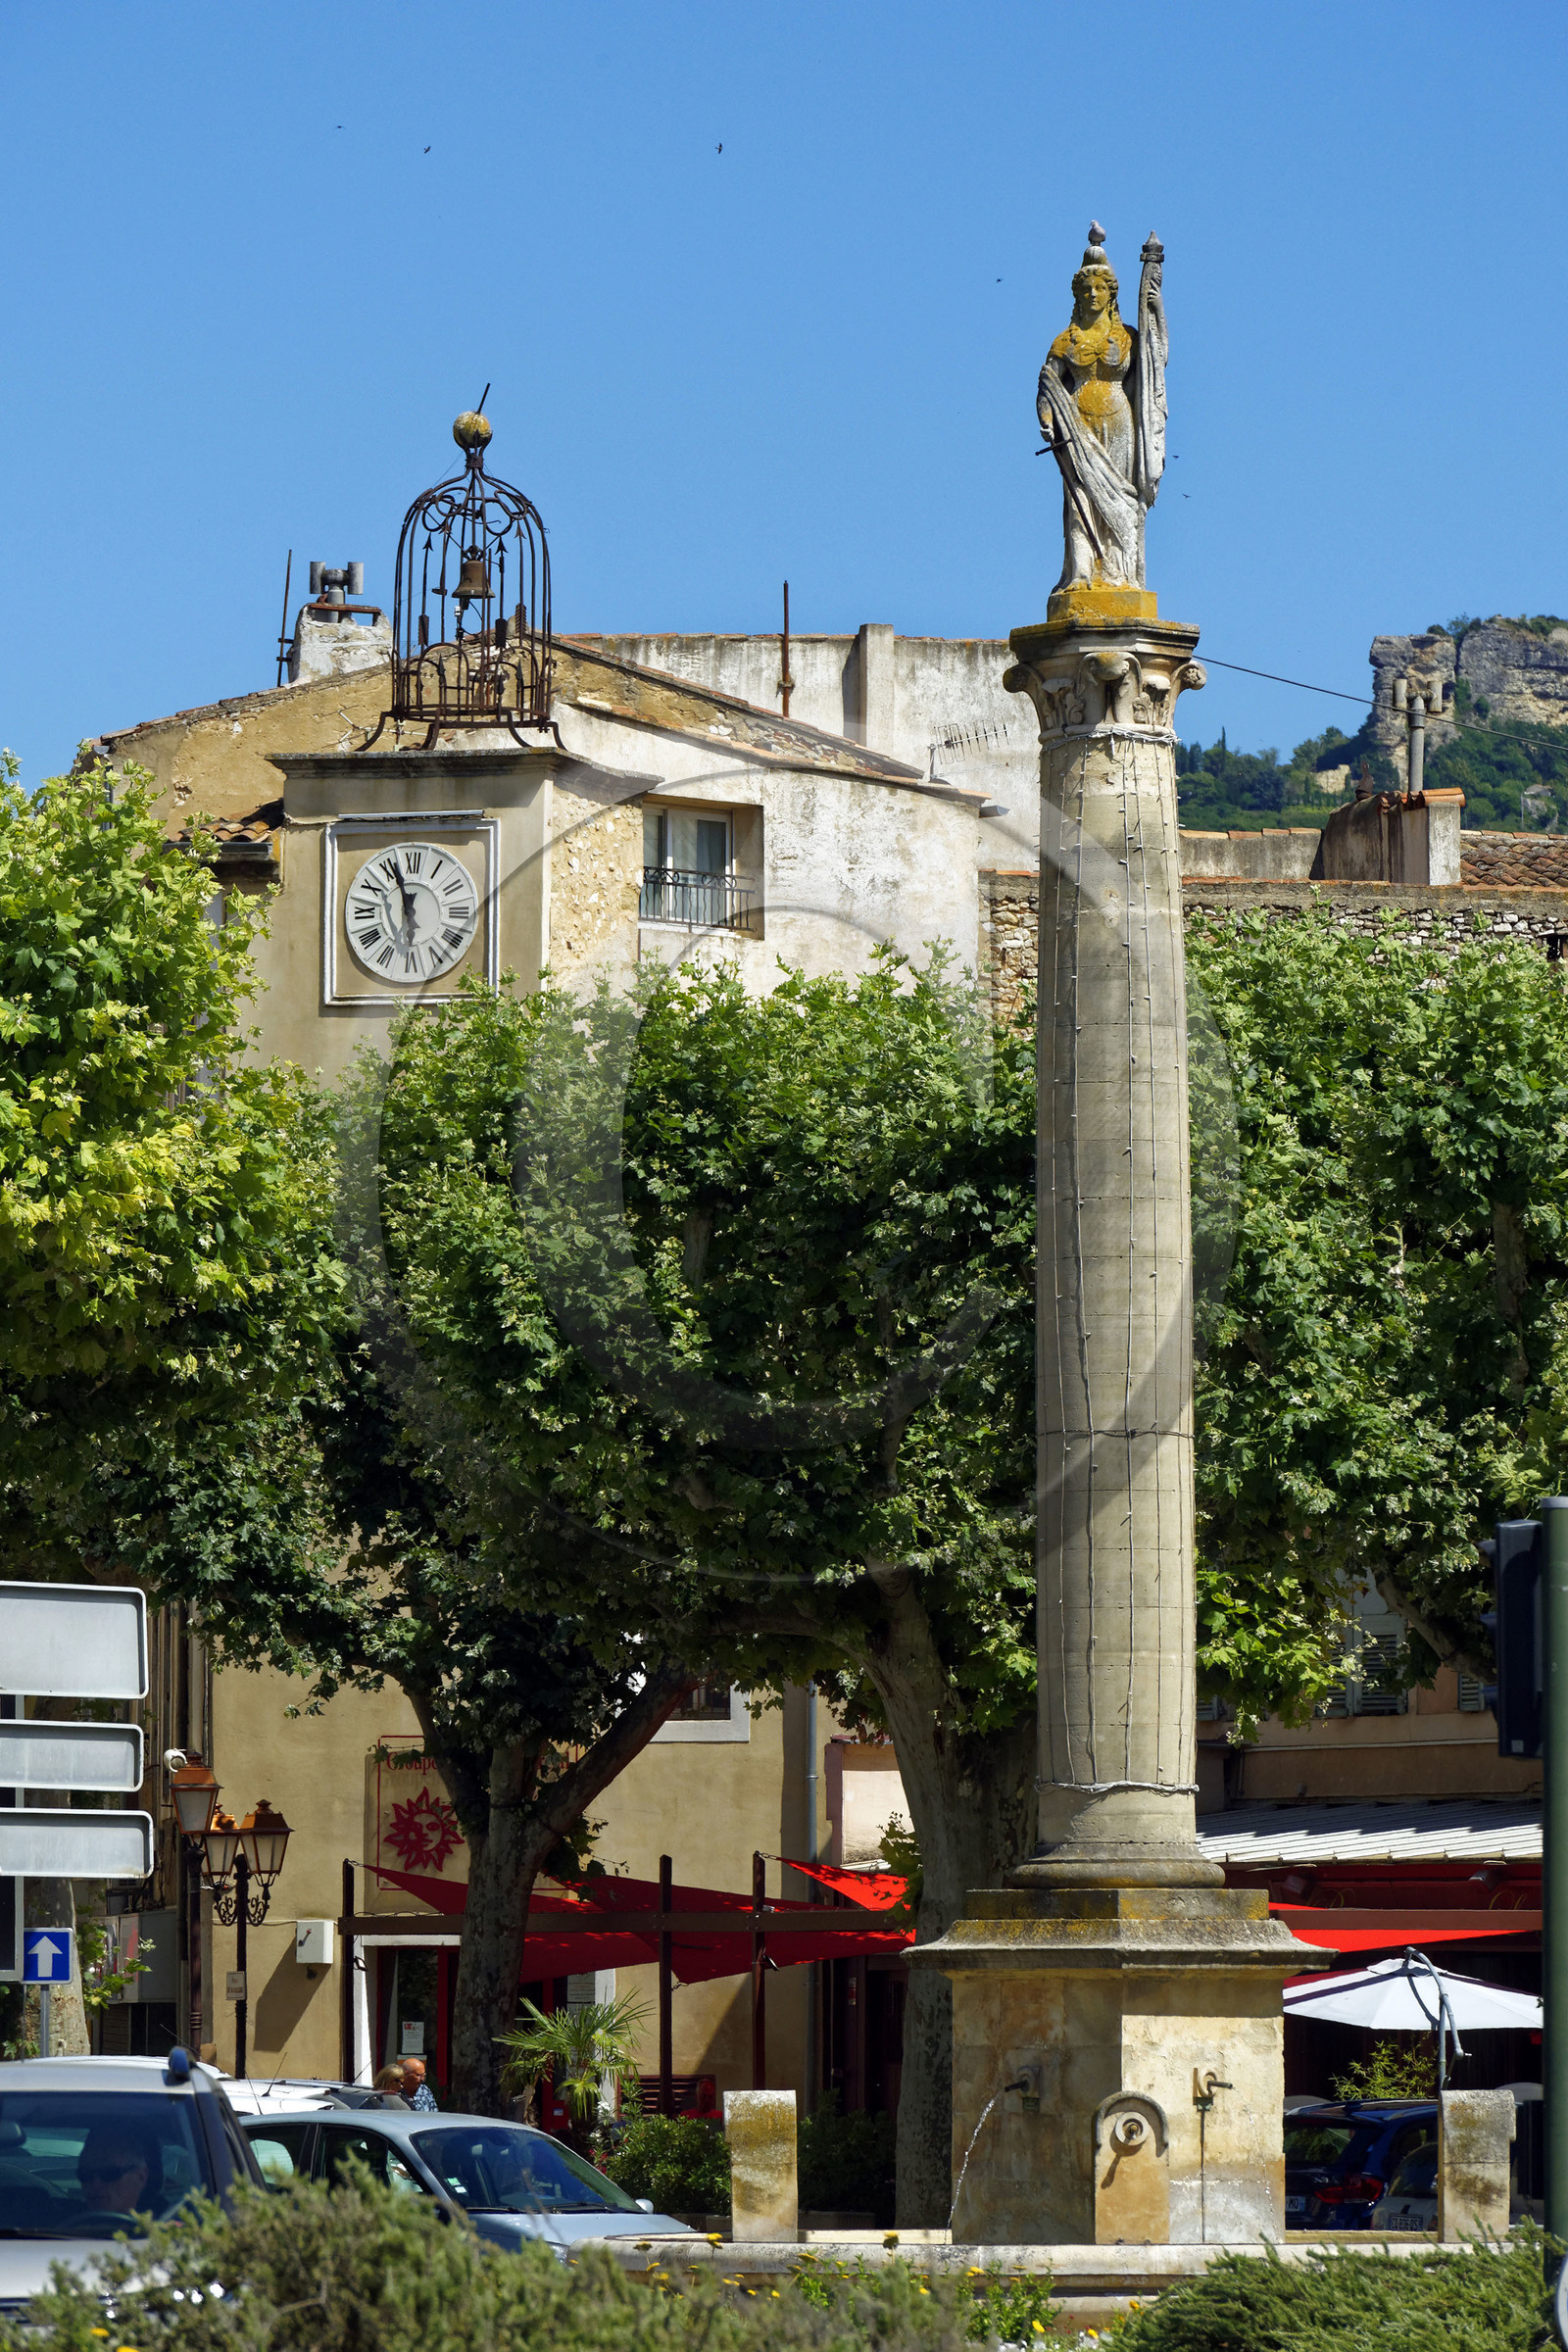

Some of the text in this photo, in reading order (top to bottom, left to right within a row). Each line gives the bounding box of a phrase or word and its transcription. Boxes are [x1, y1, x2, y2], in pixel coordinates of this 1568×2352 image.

[406, 852, 421, 874] XII
[431, 859, 443, 880] I
[360, 878, 381, 897] X
[442, 878, 464, 896] II
[354, 906, 375, 920] IX
[448, 906, 469, 919] III
[376, 945, 395, 968] VII
[404, 951, 417, 973] VI
[429, 946, 444, 968] V
